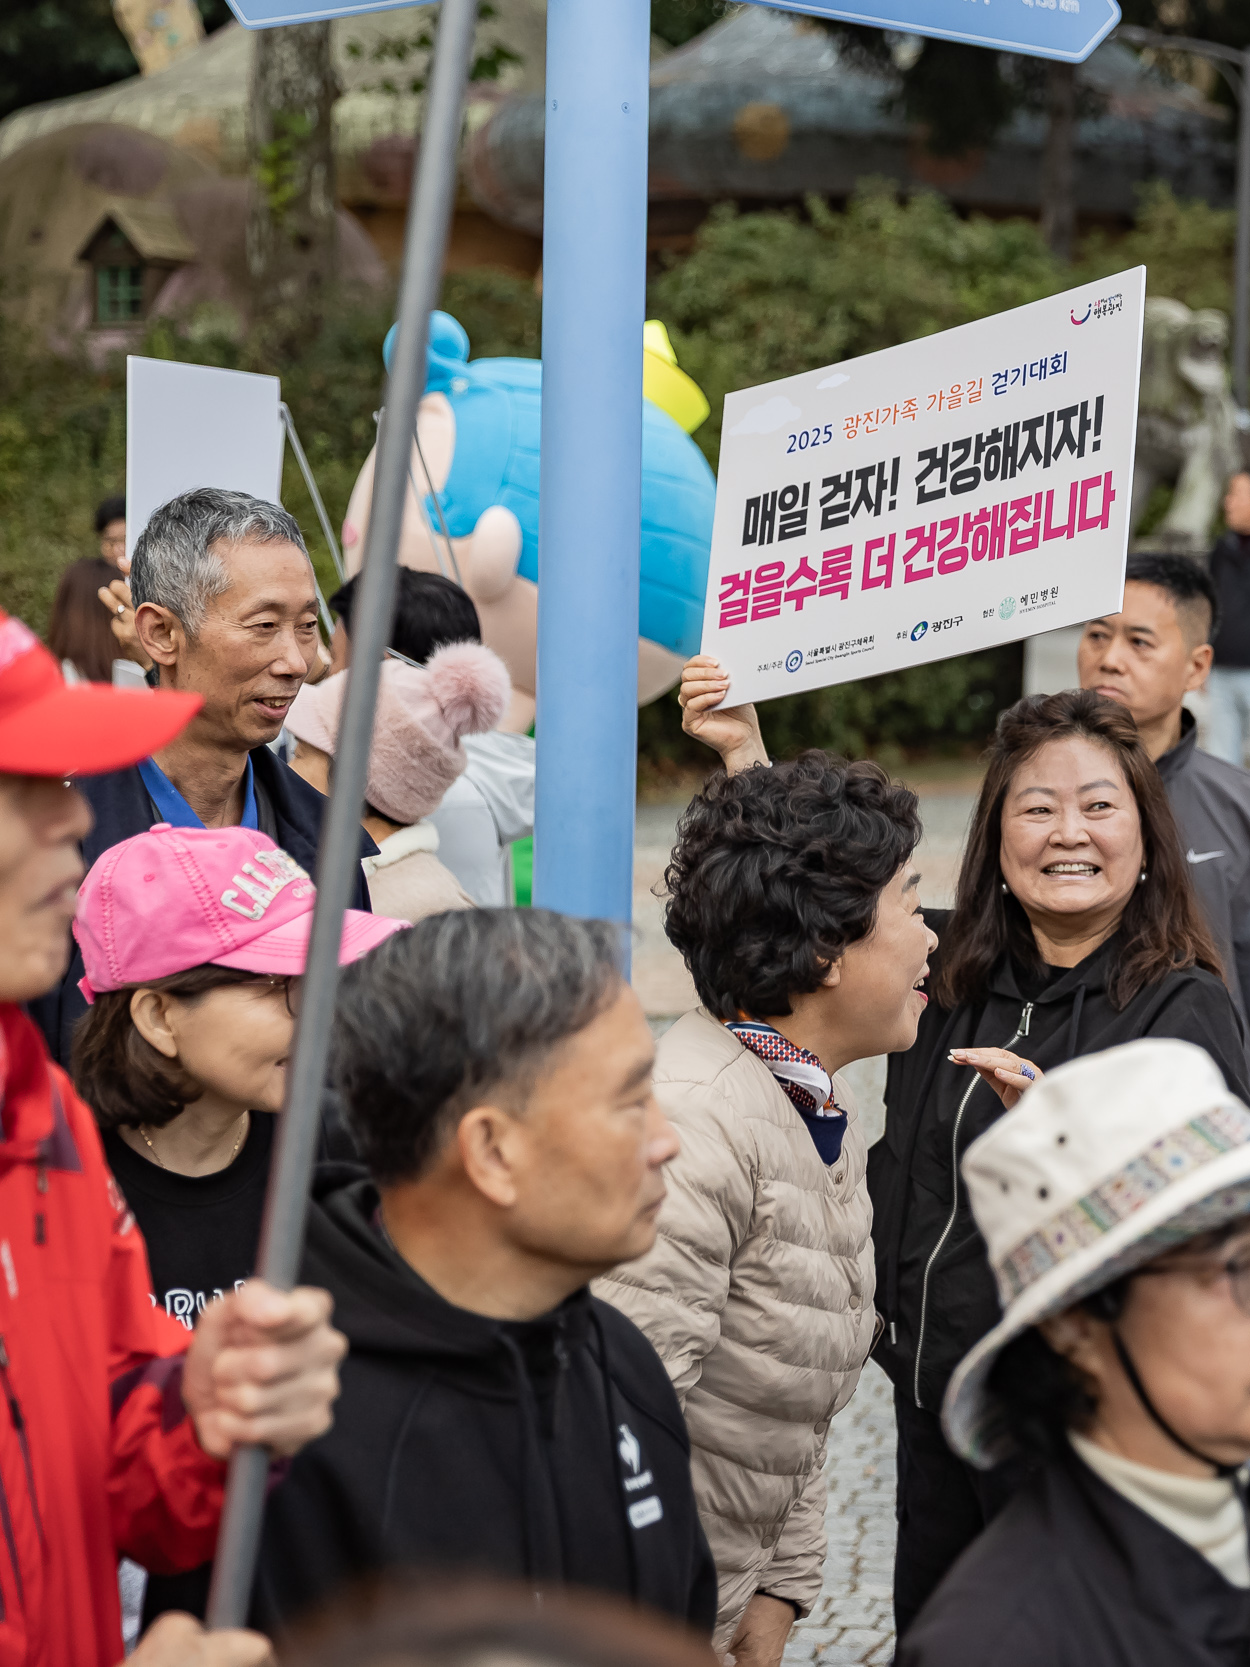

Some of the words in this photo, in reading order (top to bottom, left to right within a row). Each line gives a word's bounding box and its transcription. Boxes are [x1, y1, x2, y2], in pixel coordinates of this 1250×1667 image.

[1093, 299, 1123, 319] 행복광진
[786, 424, 834, 454] 2025
[842, 396, 919, 440] 광진가족
[926, 377, 985, 413] 가을길
[991, 350, 1069, 396] 걷기대회
[741, 481, 811, 547] 매일
[819, 456, 901, 531] 걷자!
[914, 394, 1105, 505] 건강해지자!
[718, 544, 854, 630] 걸을수록
[861, 532, 896, 592] 더
[902, 470, 1116, 587] 건강해집니다
[1019, 585, 1060, 607] 혜민병원
[931, 615, 964, 633] 광진구
[806, 643, 837, 658] 서울특별시
